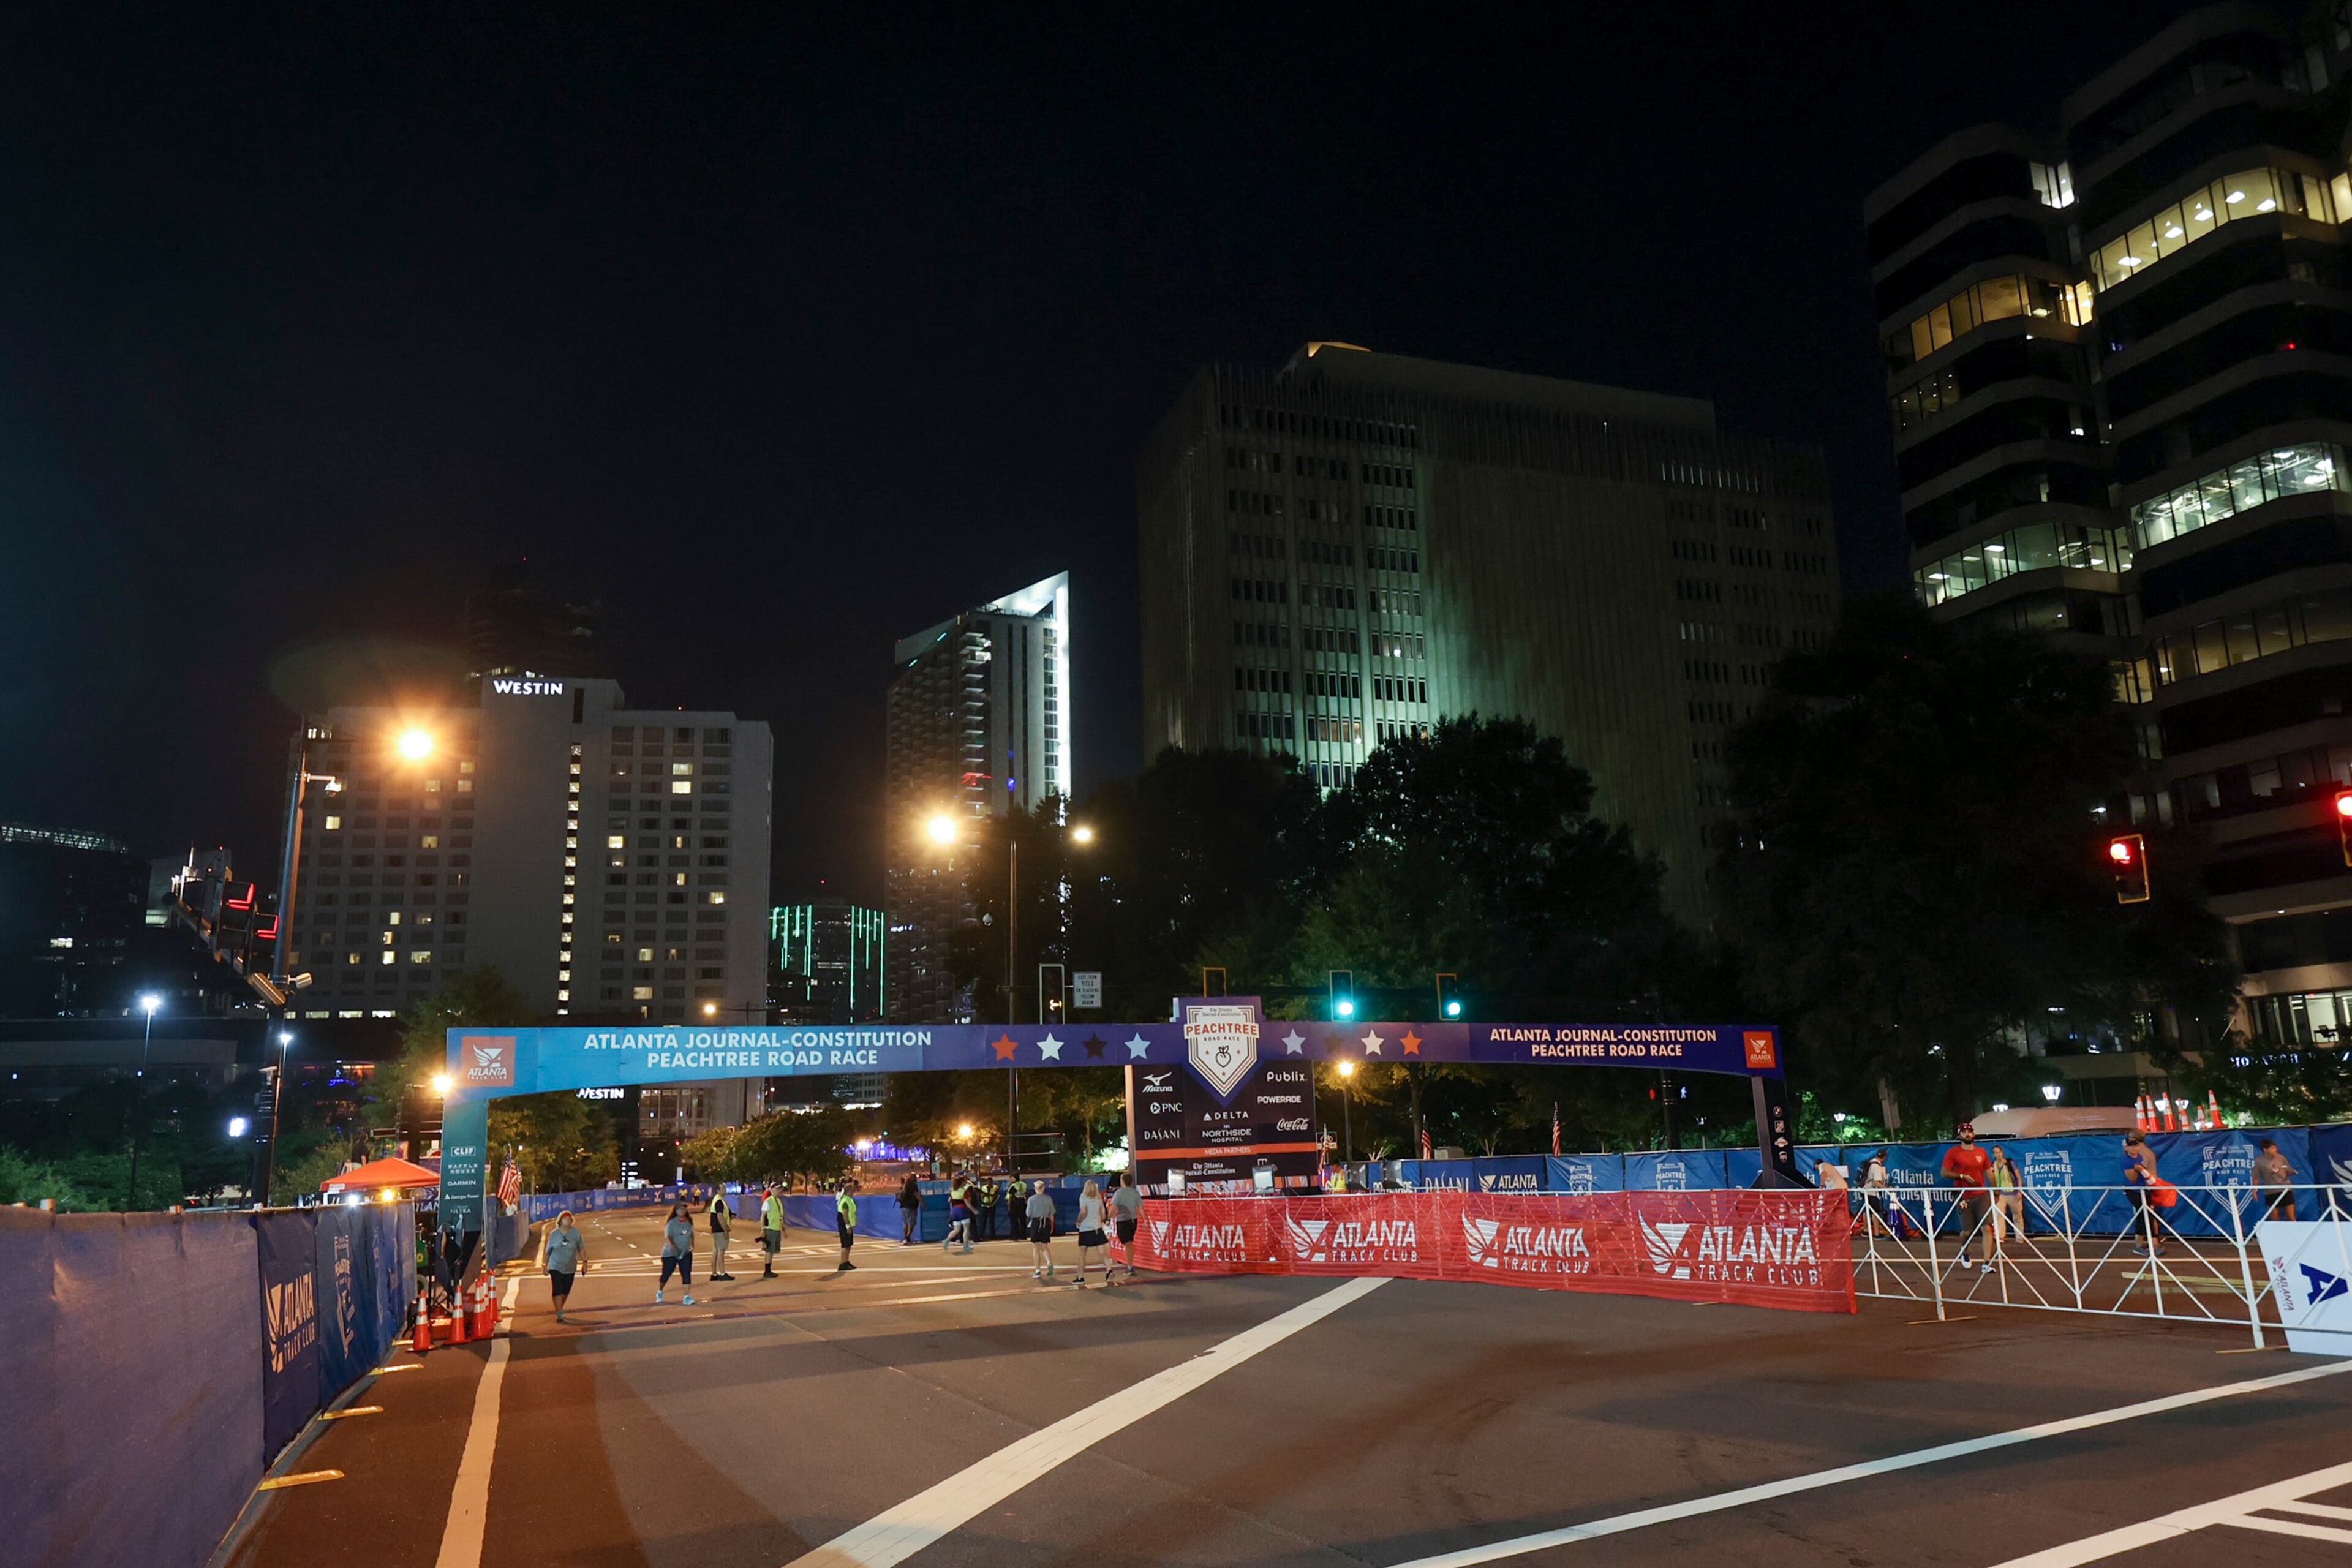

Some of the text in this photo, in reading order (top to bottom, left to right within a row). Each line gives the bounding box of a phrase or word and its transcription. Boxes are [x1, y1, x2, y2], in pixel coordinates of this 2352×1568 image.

[493, 680, 563, 695] WESTIN
[1186, 1023, 1257, 1036] PEACHTREE
[1490, 1028, 1717, 1042] ATLANTA JOURNAL-CONSTITUTION
[584, 1031, 932, 1049] ATLANTA JOURNAL-CONSTITUTION
[1532, 1044, 1683, 1057] PEACHTREE ROAD RACE
[647, 1050, 878, 1068] PEACHTREE ROAD RACE
[467, 1068, 507, 1076] ATLANTA
[1267, 1071, 1305, 1082] Publix
[1257, 1095, 1302, 1104] POWERADE
[1161, 1102, 1183, 1112] PNC
[1214, 1110, 1249, 1120] DELTA
[1144, 1128, 1181, 1141] DASANI
[1202, 1128, 1252, 1137] NORTHSIDE
[1185, 1168, 1236, 1177] urnal-Constitution
[2024, 1163, 2073, 1175] PEACHTREE
[1425, 1171, 1469, 1193] DASANI
[1498, 1174, 1538, 1189] ATLANTA
[1892, 1169, 1934, 1185] Atlanta
[1174, 1224, 1245, 1248] ATLANTA
[1332, 1220, 1417, 1248] ATLANTA
[1504, 1226, 1590, 1257] ATLANTA
[1698, 1226, 1817, 1265] ATLANTA
[1173, 1250, 1246, 1261] TRACK CLUB
[1332, 1249, 1418, 1262] TRACK CLUB
[1504, 1257, 1589, 1273] TRACK CLUB
[1698, 1265, 1818, 1286] TRACK CLUB
[2278, 1275, 2295, 1311] ATLANTA
[284, 1272, 314, 1337] ATLANTA
